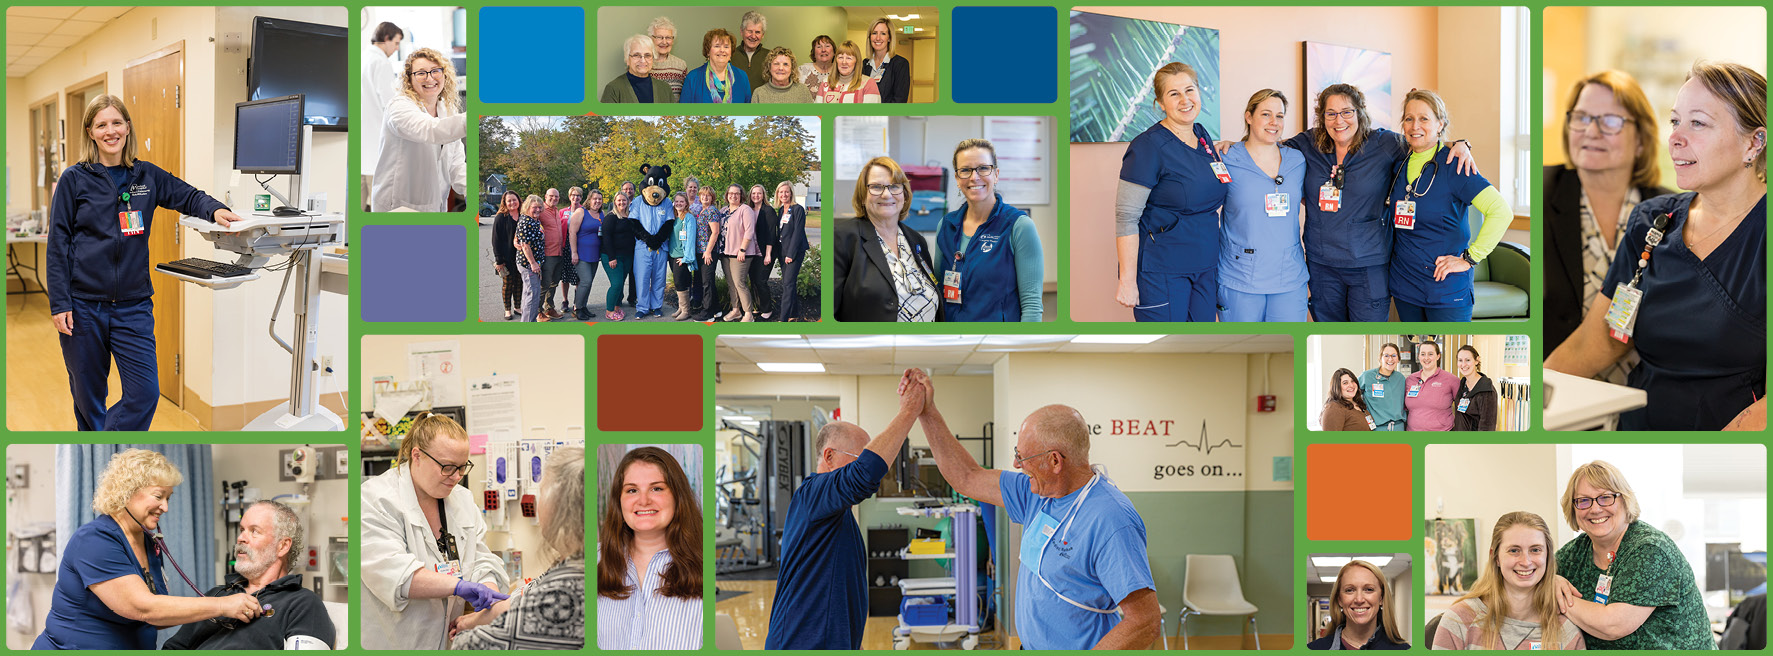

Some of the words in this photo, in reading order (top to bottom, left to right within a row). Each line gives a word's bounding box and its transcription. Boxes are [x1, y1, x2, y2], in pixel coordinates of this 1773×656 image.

[1398, 216, 1410, 225] RN
[948, 290, 954, 298] RN
[1110, 419, 1174, 436] BEAT
[778, 446, 790, 492] CYBEX
[1154, 464, 1194, 480] goes
[1201, 464, 1242, 476] on...
